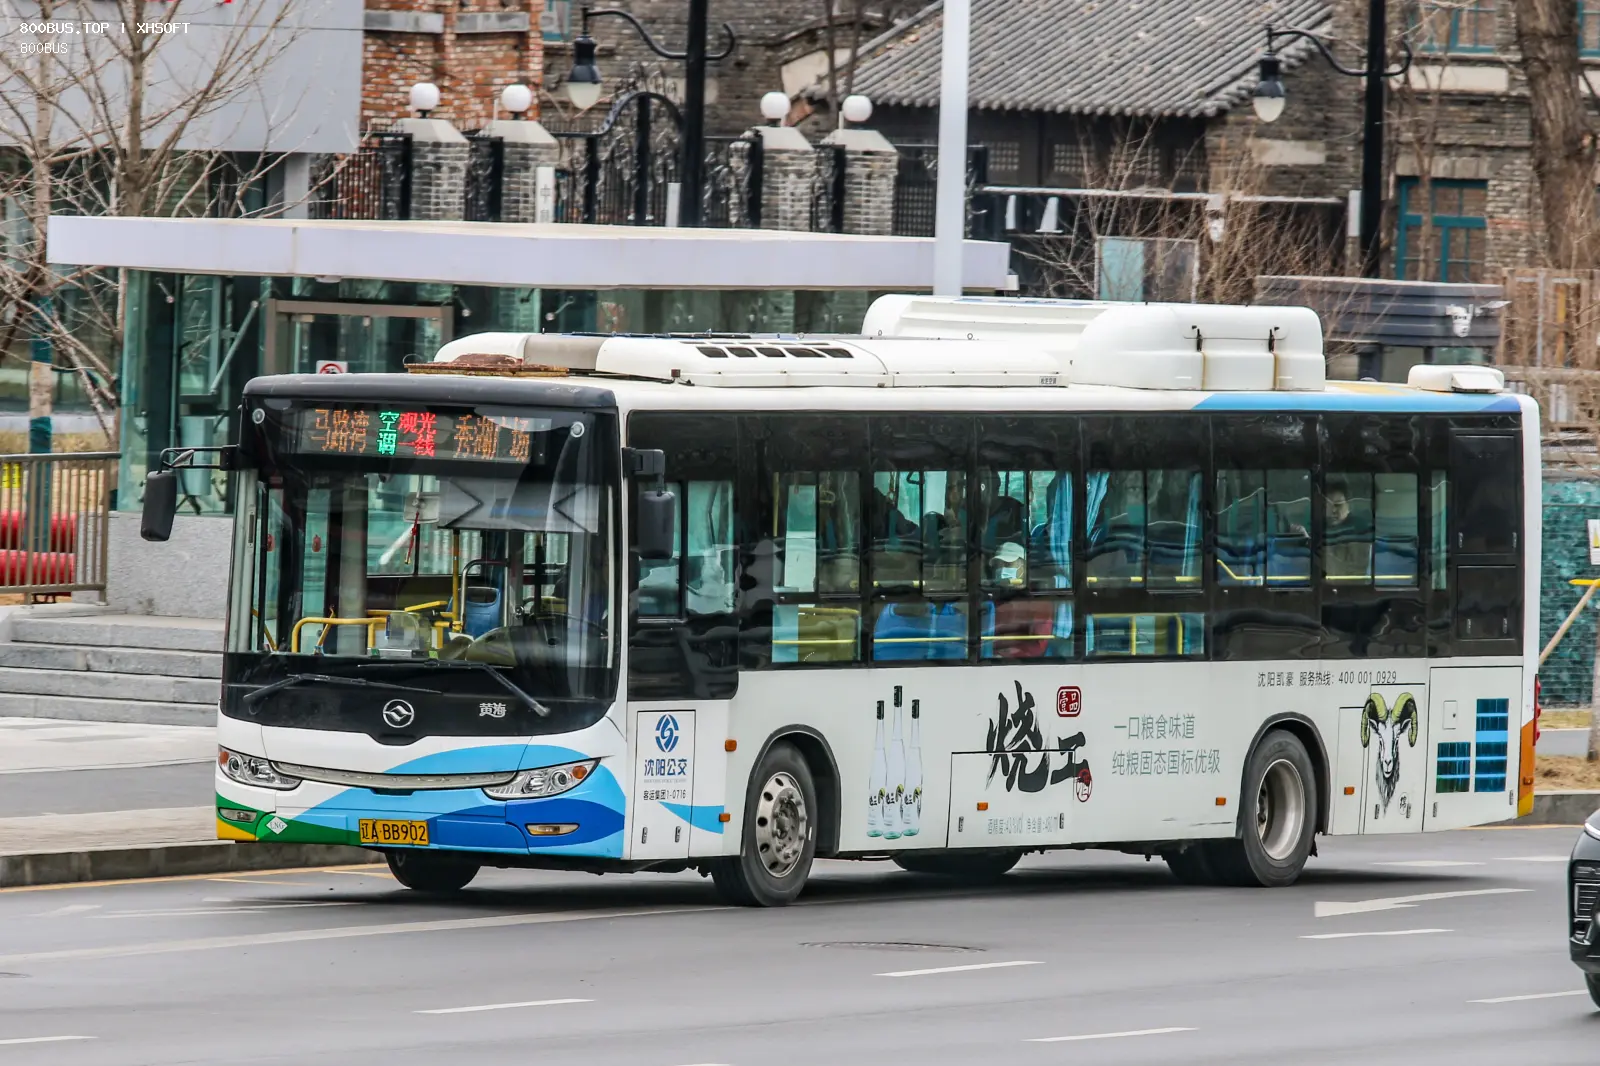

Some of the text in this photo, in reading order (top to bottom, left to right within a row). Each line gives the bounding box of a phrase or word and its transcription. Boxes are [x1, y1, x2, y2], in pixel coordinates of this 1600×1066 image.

[311, 409, 369, 453] 马路湾
[377, 411, 400, 455] 空调
[398, 412, 437, 435] 观光
[398, 433, 436, 457] 一线
[1258, 671, 1294, 687] 沈阳凯豪
[1339, 671, 1354, 684] 400
[1358, 671, 1372, 684] 001
[1376, 670, 1397, 684] 0929
[479, 702, 507, 718] 黄海
[1114, 714, 1196, 740] 一口粮食味道
[644, 758, 688, 777] 沈阳公交
[1112, 749, 1221, 776] 纯粮固态国标优级
